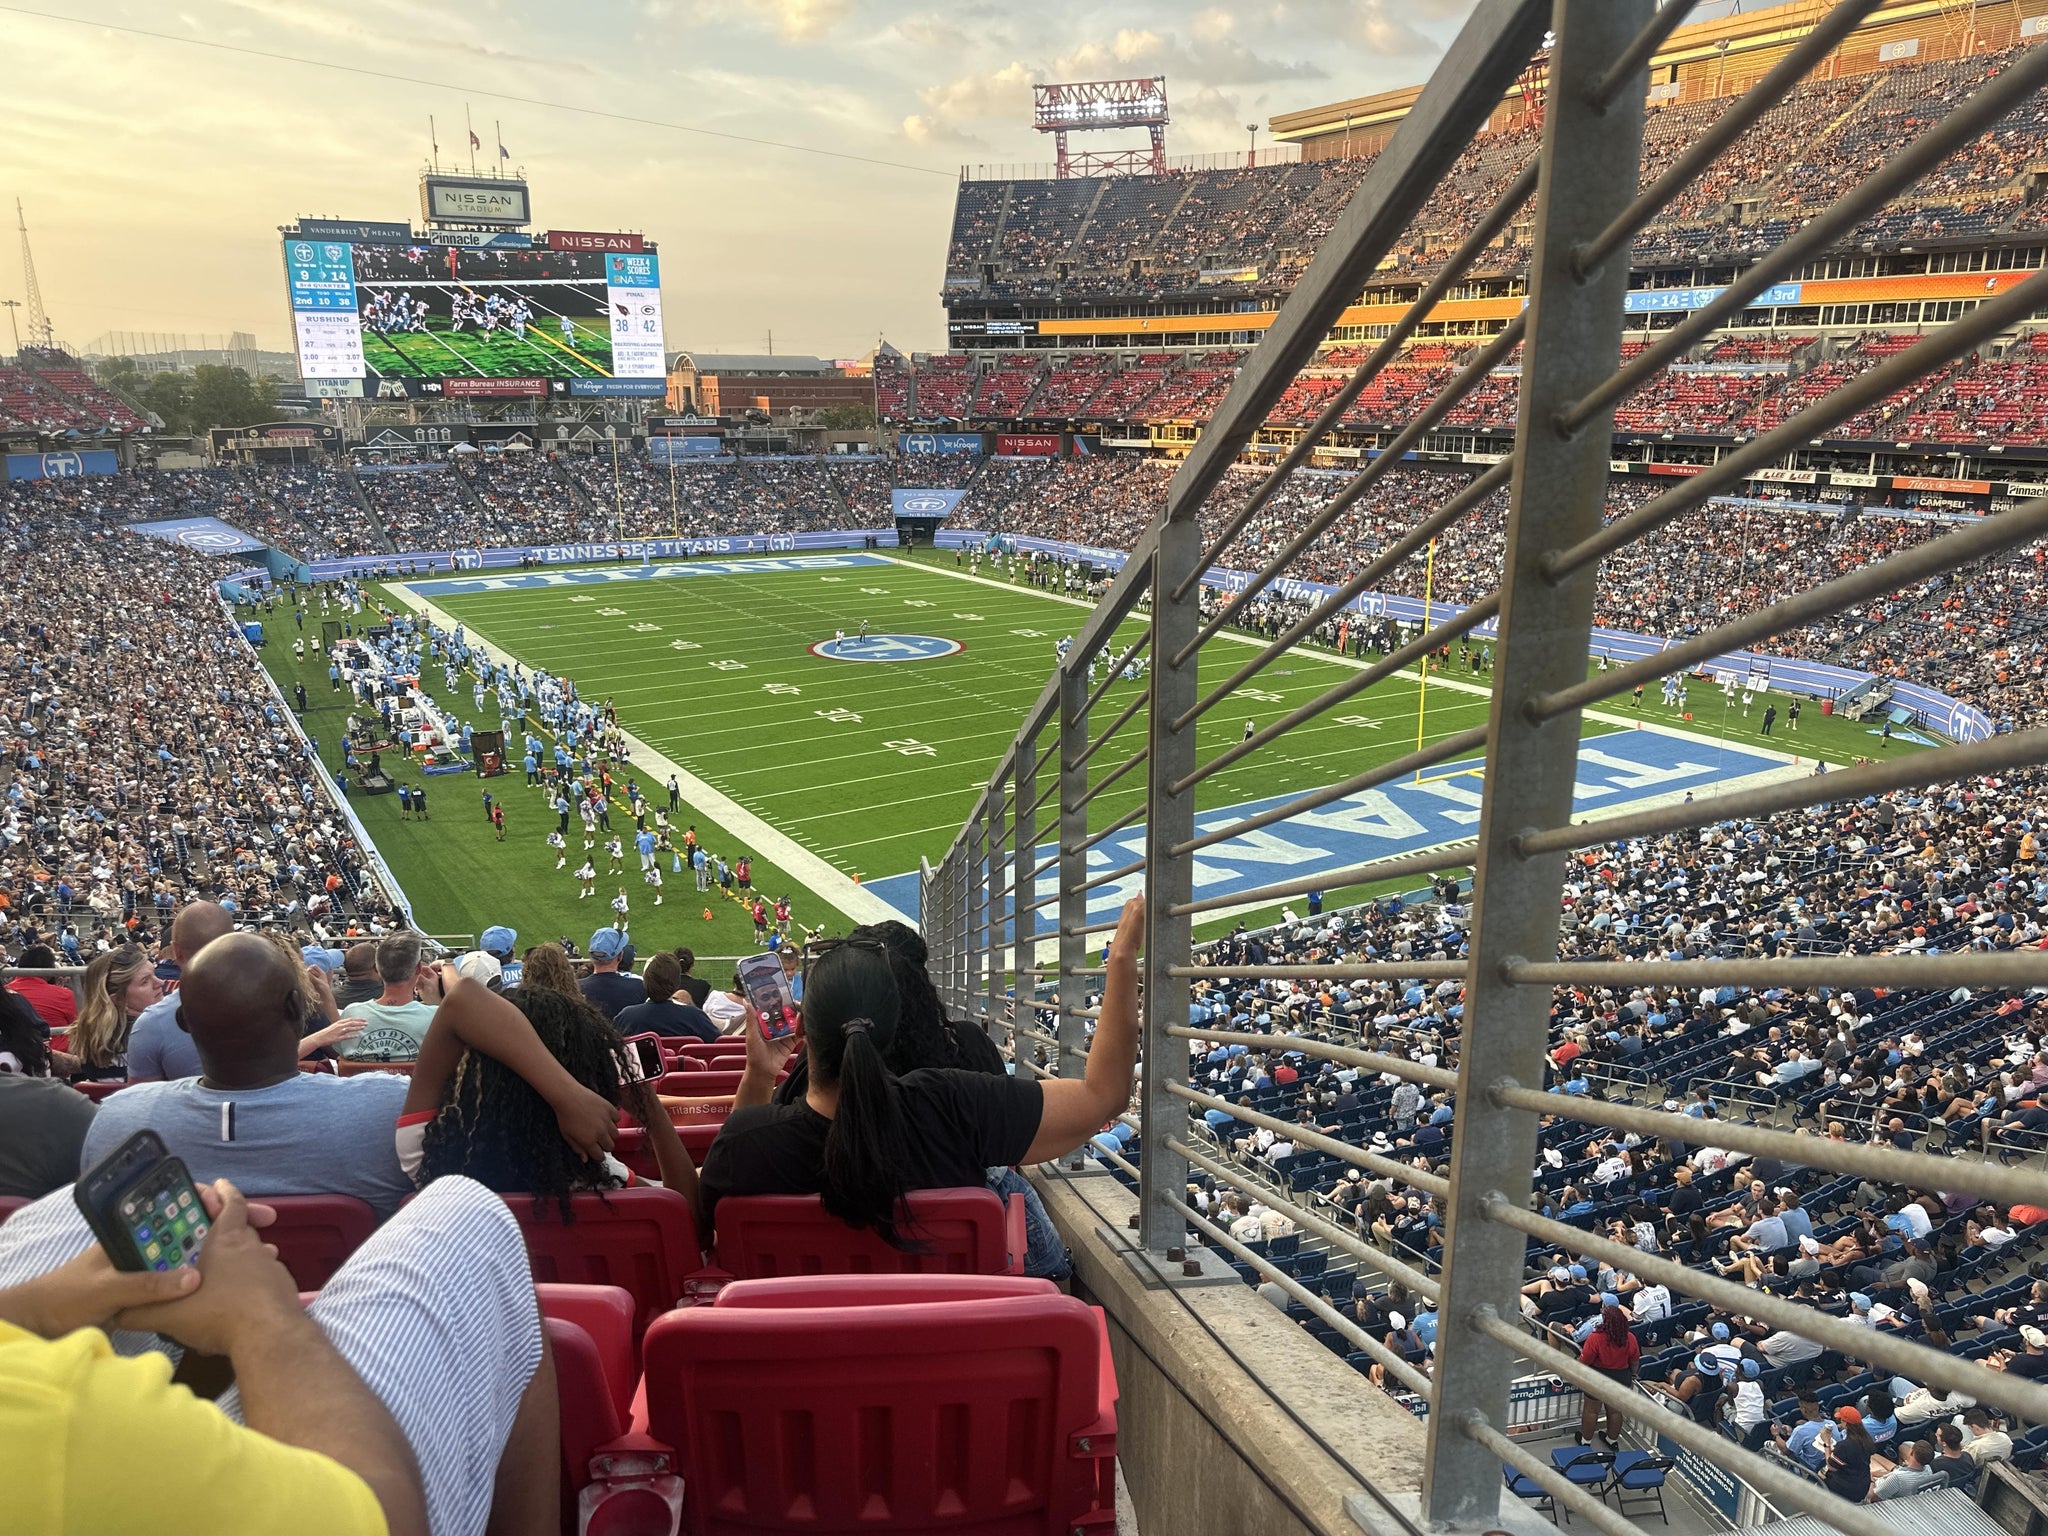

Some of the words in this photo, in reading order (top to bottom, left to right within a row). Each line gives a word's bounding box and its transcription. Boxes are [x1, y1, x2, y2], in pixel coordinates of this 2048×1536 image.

[445, 193, 511, 205] NISSAN
[457, 205, 502, 213] STADIUM
[310, 227, 358, 235] VANDERBILT
[431, 232, 480, 245] Pinnacle
[561, 236, 632, 249] NISSAN
[626, 257, 645, 267] WEEK
[645, 258, 650, 267] 4
[300, 270, 309, 280] 9
[331, 271, 347, 281] 14
[627, 266, 651, 275] SCORES
[1661, 296, 1679, 307] 14
[1774, 290, 1796, 301] 3rd
[615, 319, 629, 332] 38
[643, 319, 656, 332] 42
[316, 379, 338, 387] TITAN
[449, 380, 468, 388] Farm
[469, 380, 495, 388] Bureau
[496, 380, 541, 388] INSURANCE
[583, 381, 604, 393] Kroger
[953, 438, 978, 450] Kroger
[1004, 439, 1052, 447] NISSAN
[1771, 471, 1785, 479] LEE
[1907, 479, 1935, 489] Tito's
[1820, 492, 1853, 500] BRAZE
[1920, 512, 1950, 521] TITANS
[531, 541, 657, 561] TENNESSEE
[661, 539, 731, 554] TITANS
[450, 558, 854, 590] TITANS
[708, 659, 749, 671] 50
[761, 683, 802, 696] 40
[813, 707, 864, 724] 30
[881, 738, 938, 757] 20
[367, 1030, 407, 1042] CODY
[367, 1039, 404, 1053] WYOMING
[1653, 1294, 1667, 1302] FIELDS
[1659, 1302, 1667, 1318] 1
[1510, 1386, 1546, 1400] ermobil
[1682, 1452, 1692, 1466] TIM
[1692, 1464, 1711, 1482] SHAW
[1692, 1455, 1704, 1468] ALS
